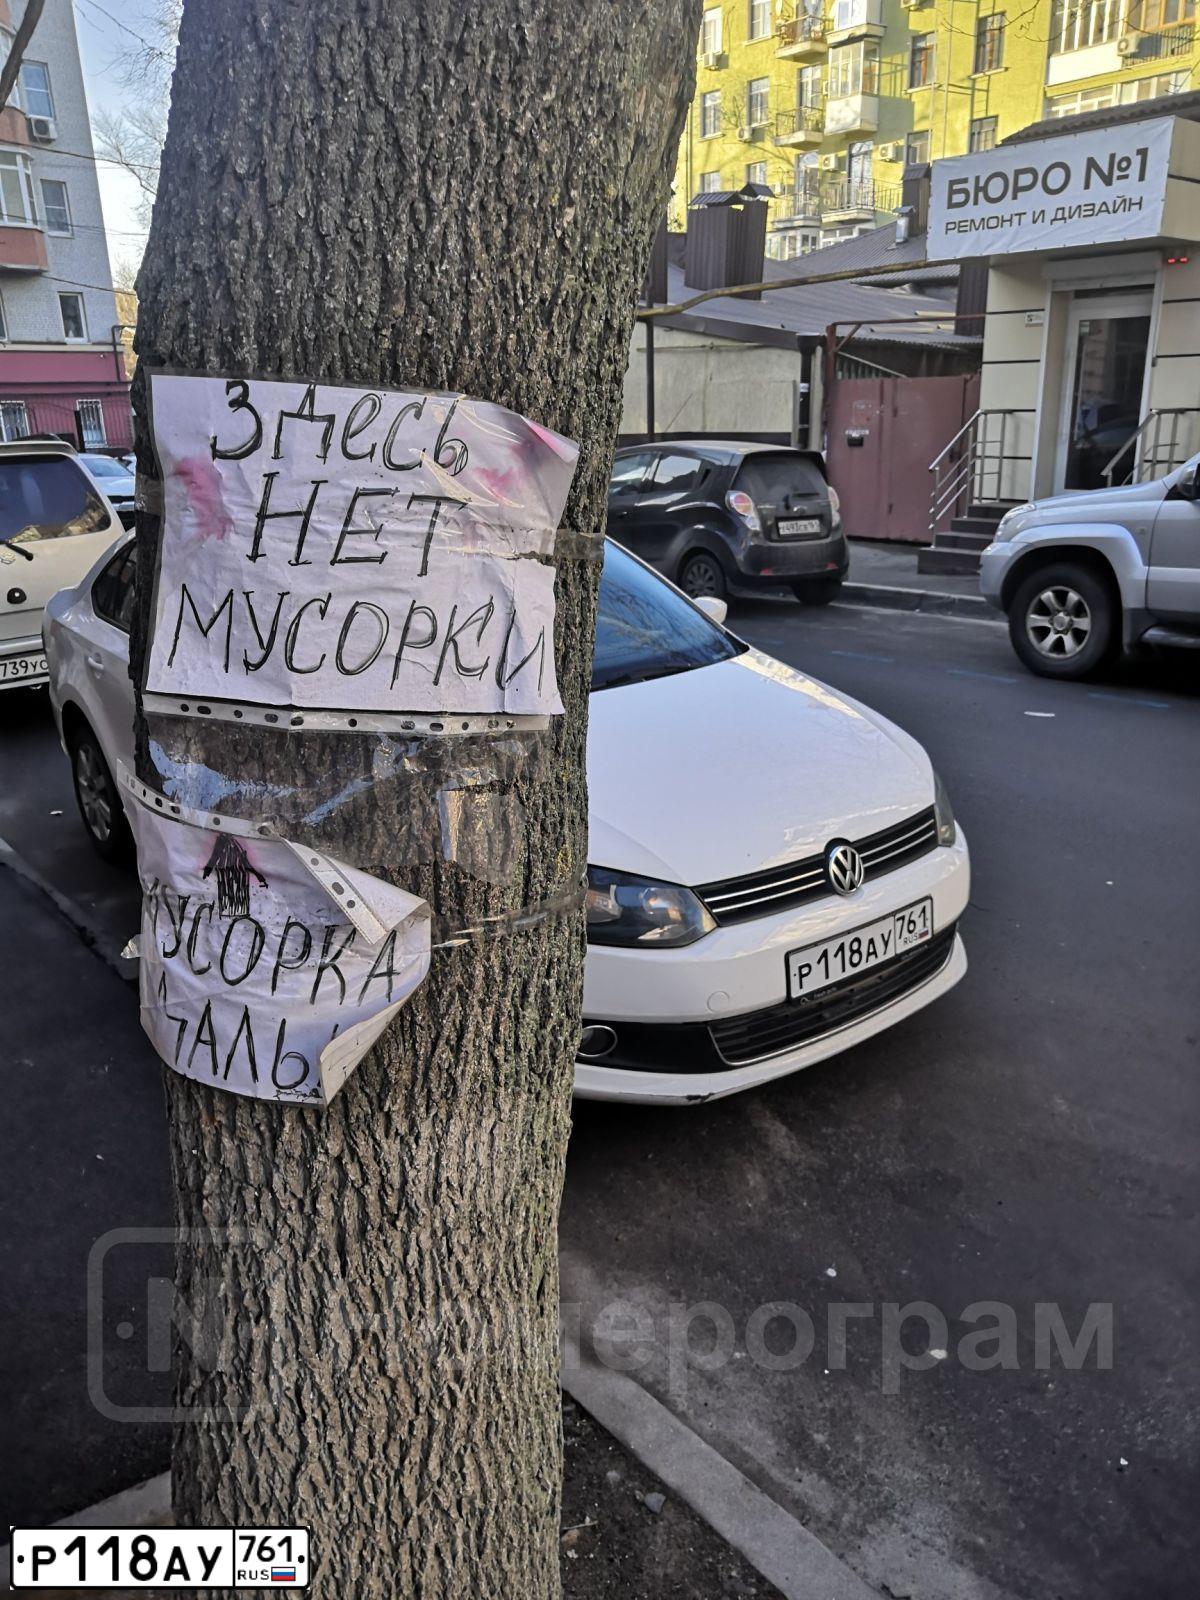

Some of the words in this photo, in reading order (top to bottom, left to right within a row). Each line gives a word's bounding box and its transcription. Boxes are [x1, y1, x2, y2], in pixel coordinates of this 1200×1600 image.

[947, 161, 1071, 209] БЮРО
[1083, 147, 1149, 190] №1
[945, 211, 1027, 235] РЕМОНТ
[1032, 208, 1046, 225] И
[1050, 195, 1144, 226] ДИЗАЙН
[246, 471, 472, 577] НЕТ
[167, 583, 546, 698] МУСОРКИ
[797, 929, 892, 989] Р118АУ
[896, 905, 928, 940] 761
[903, 932, 918, 945] RUS
